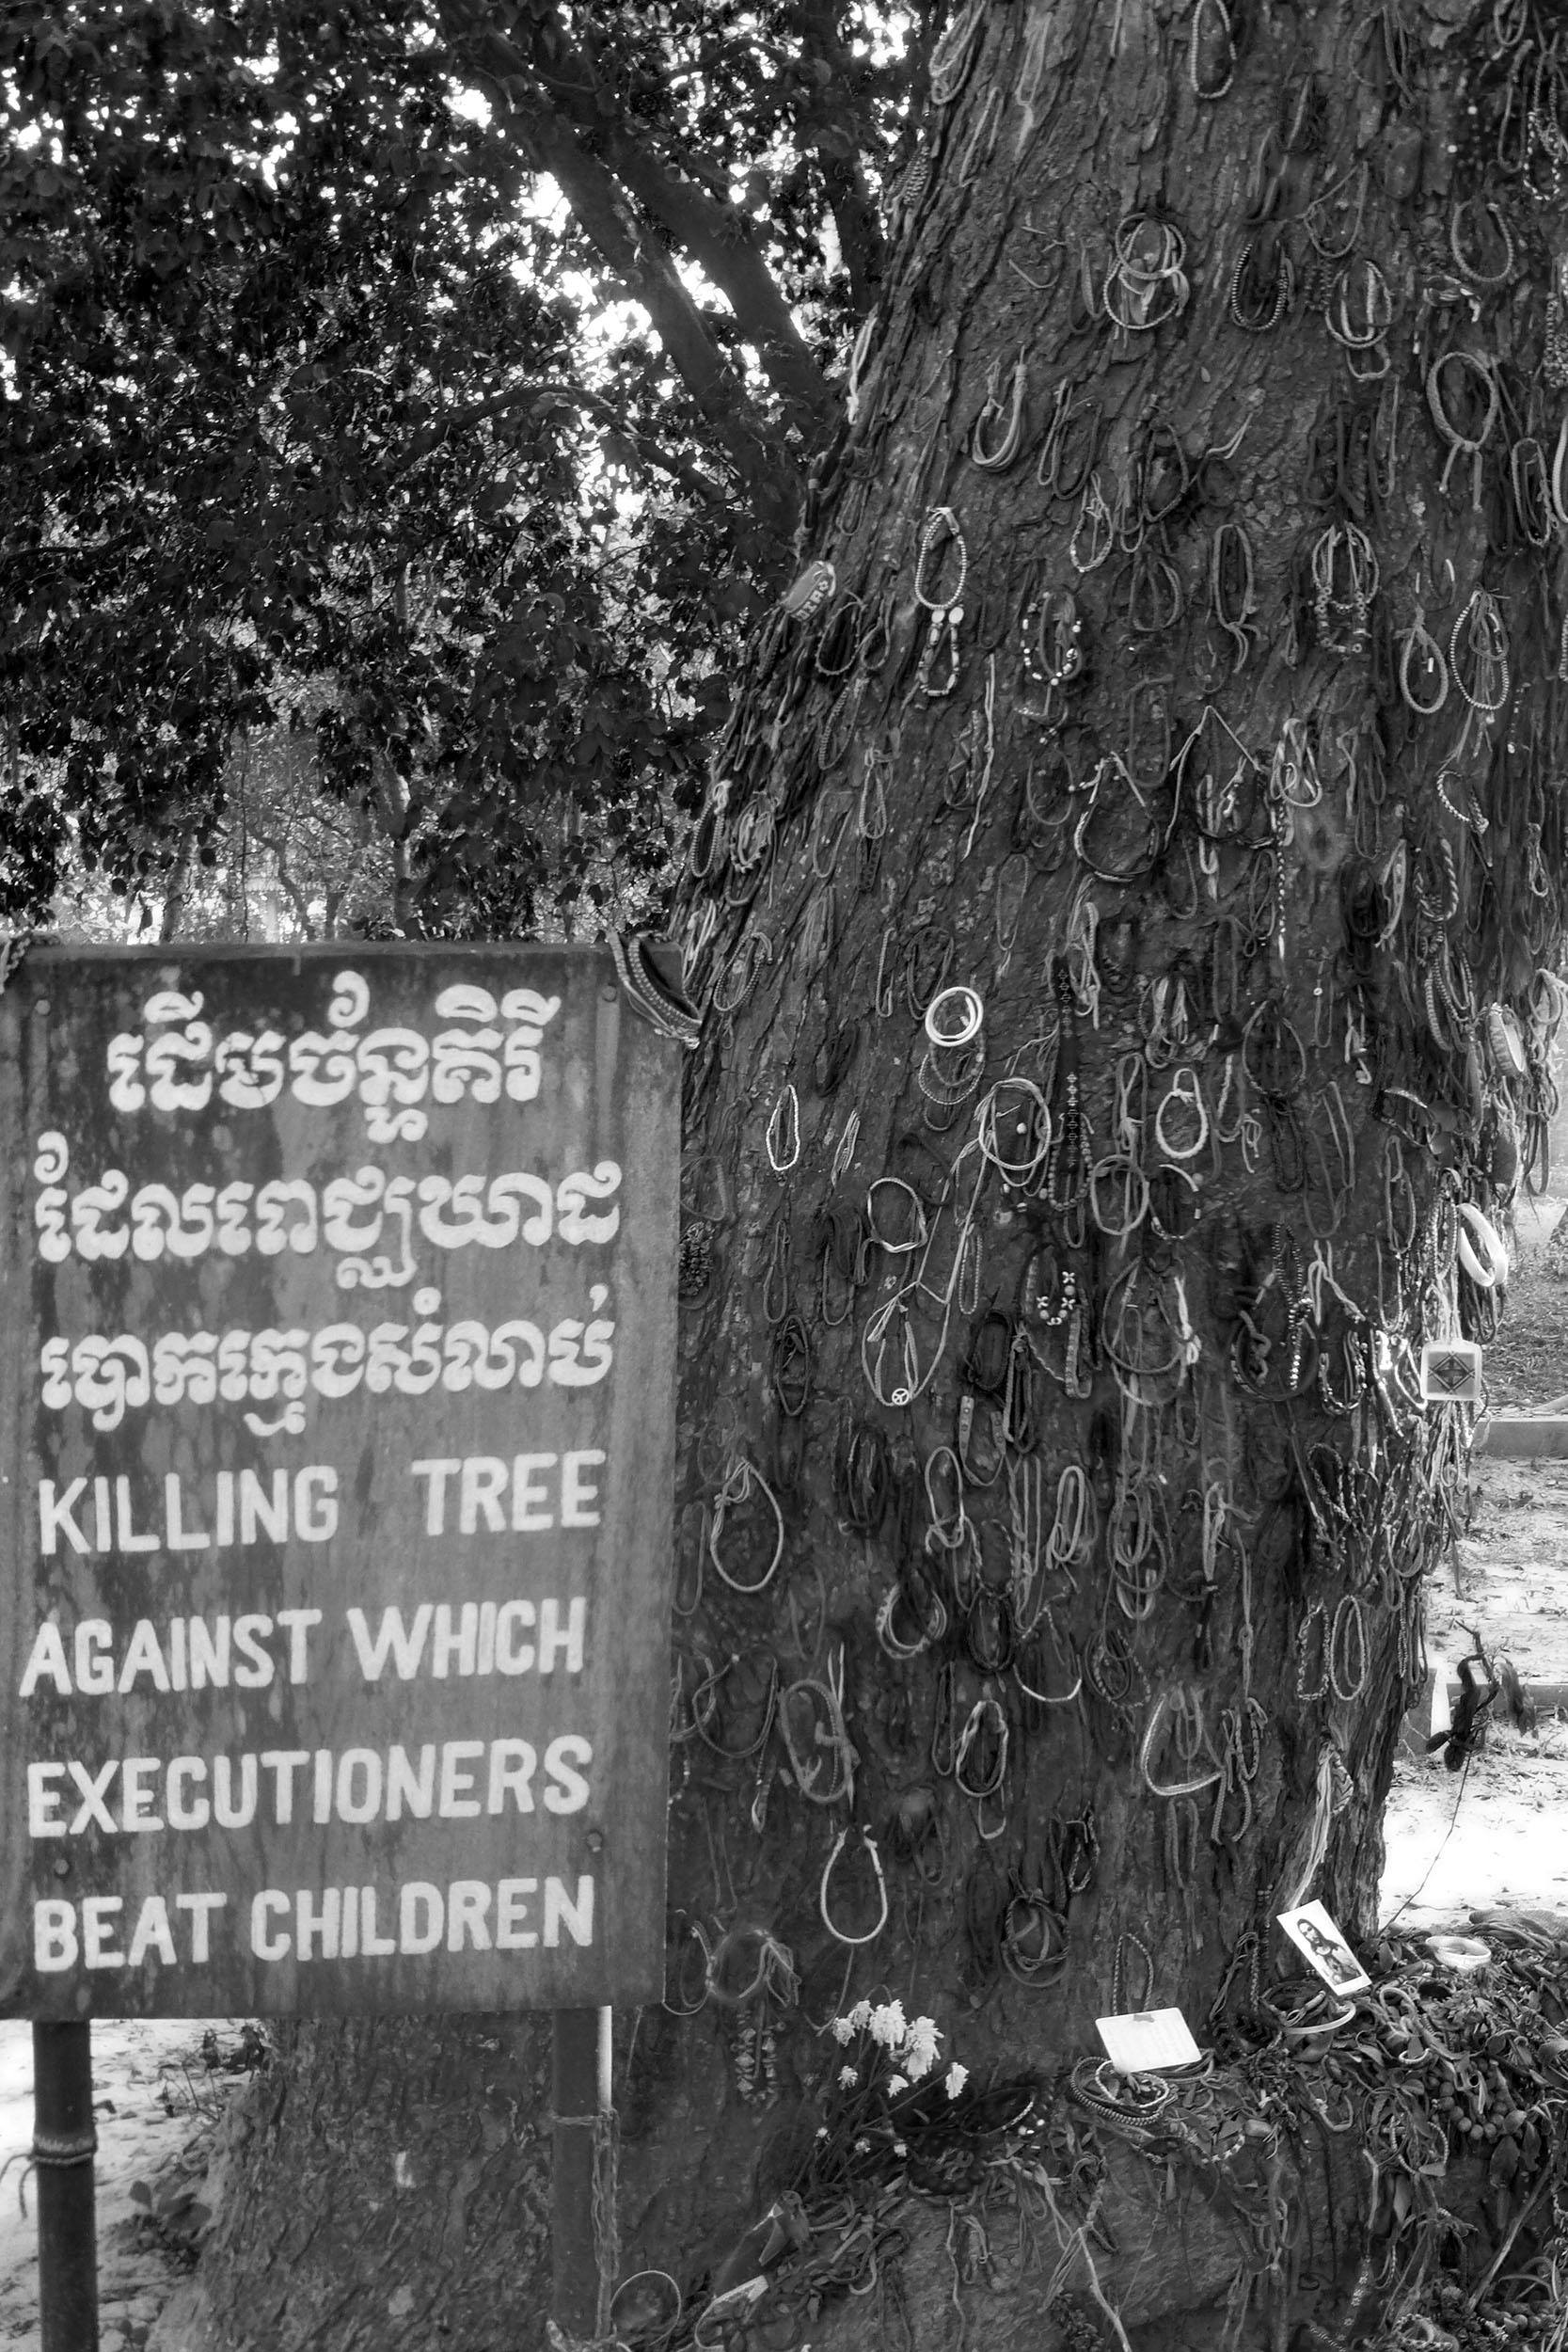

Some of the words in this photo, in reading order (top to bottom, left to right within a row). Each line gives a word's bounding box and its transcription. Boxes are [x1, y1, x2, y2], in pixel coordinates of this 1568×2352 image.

[39, 1465, 340, 1555] KILLING
[410, 1449, 607, 1537] TREE
[18, 1608, 323, 1697] AGAINST
[345, 1597, 587, 1681] WHICH
[26, 1735, 594, 1838] EXECUTIONERS
[34, 1892, 228, 1972] BEAT
[250, 1875, 594, 1962] CHILDREN
